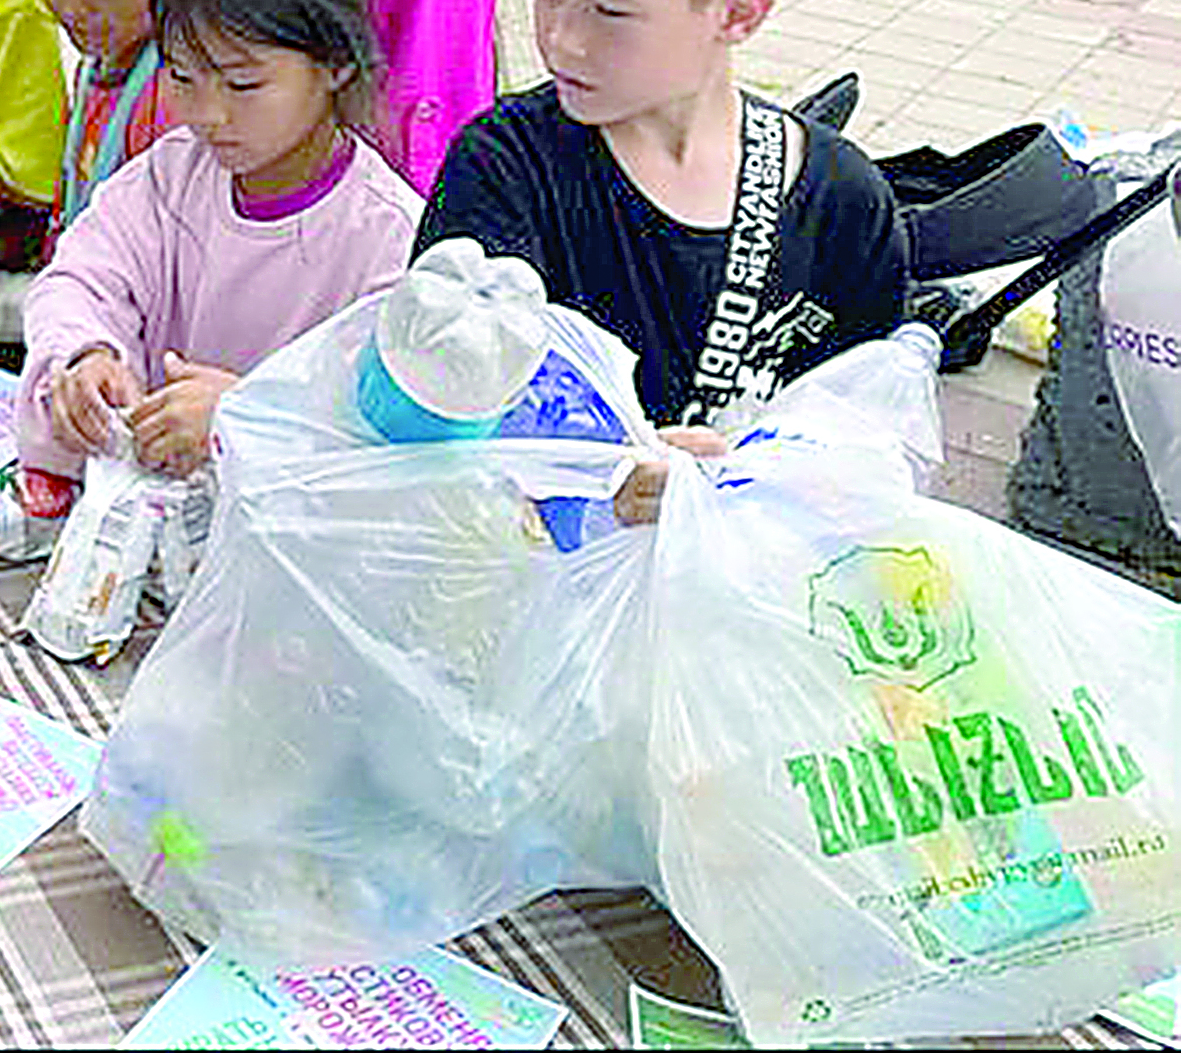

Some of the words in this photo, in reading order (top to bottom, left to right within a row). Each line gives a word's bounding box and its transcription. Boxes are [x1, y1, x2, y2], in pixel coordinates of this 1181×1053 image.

[744, 107, 782, 289] NEWFASHION
[693, 289, 759, 389] 1980
[348, 964, 445, 1046] СТИКОВ
